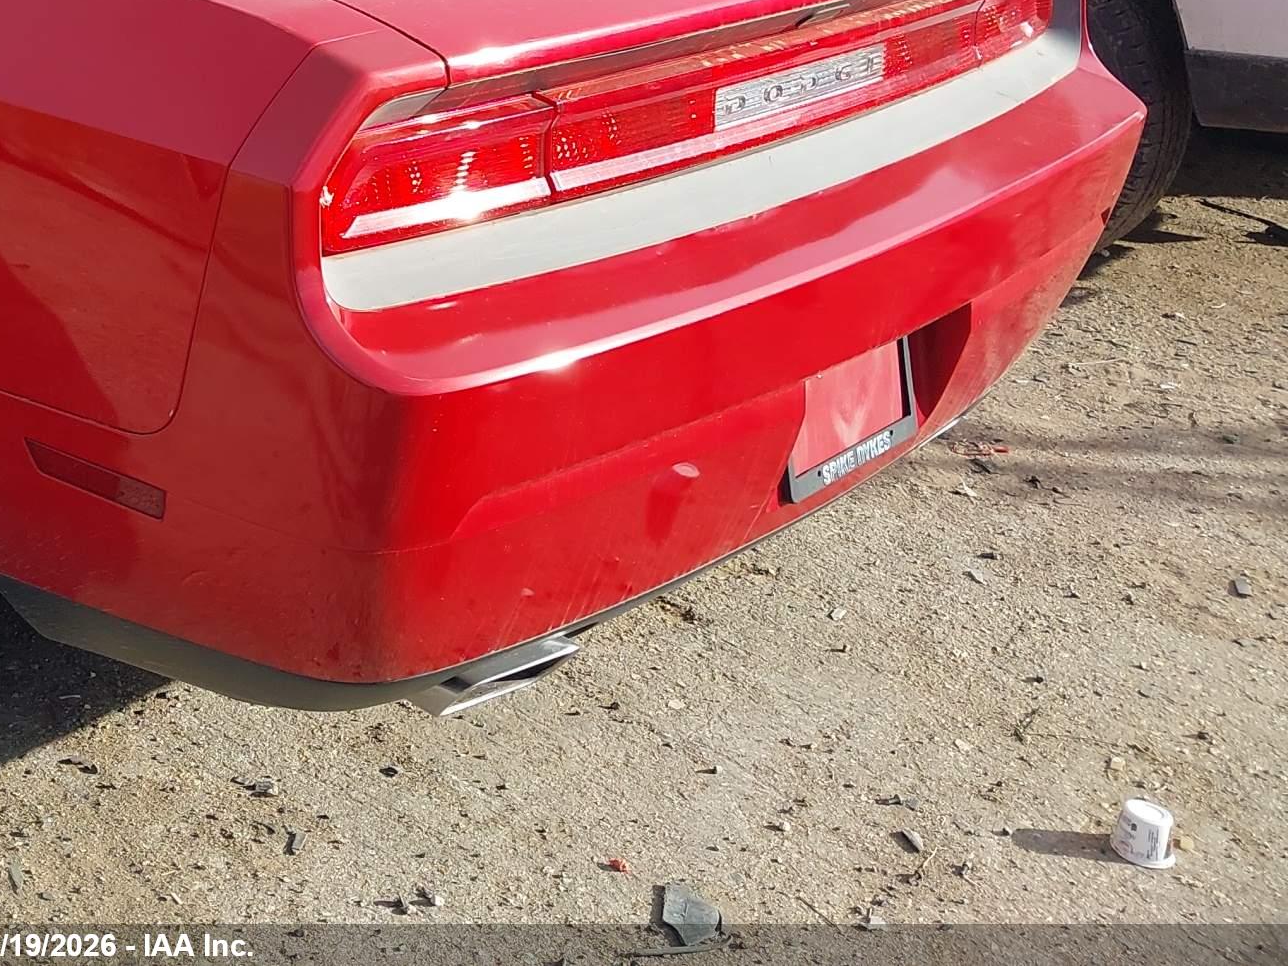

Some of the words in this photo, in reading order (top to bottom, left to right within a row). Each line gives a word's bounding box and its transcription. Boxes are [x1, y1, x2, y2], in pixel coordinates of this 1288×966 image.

[722, 53, 882, 115] DODGE
[822, 450, 856, 485] SPIKE
[856, 431, 891, 465] DYKES
